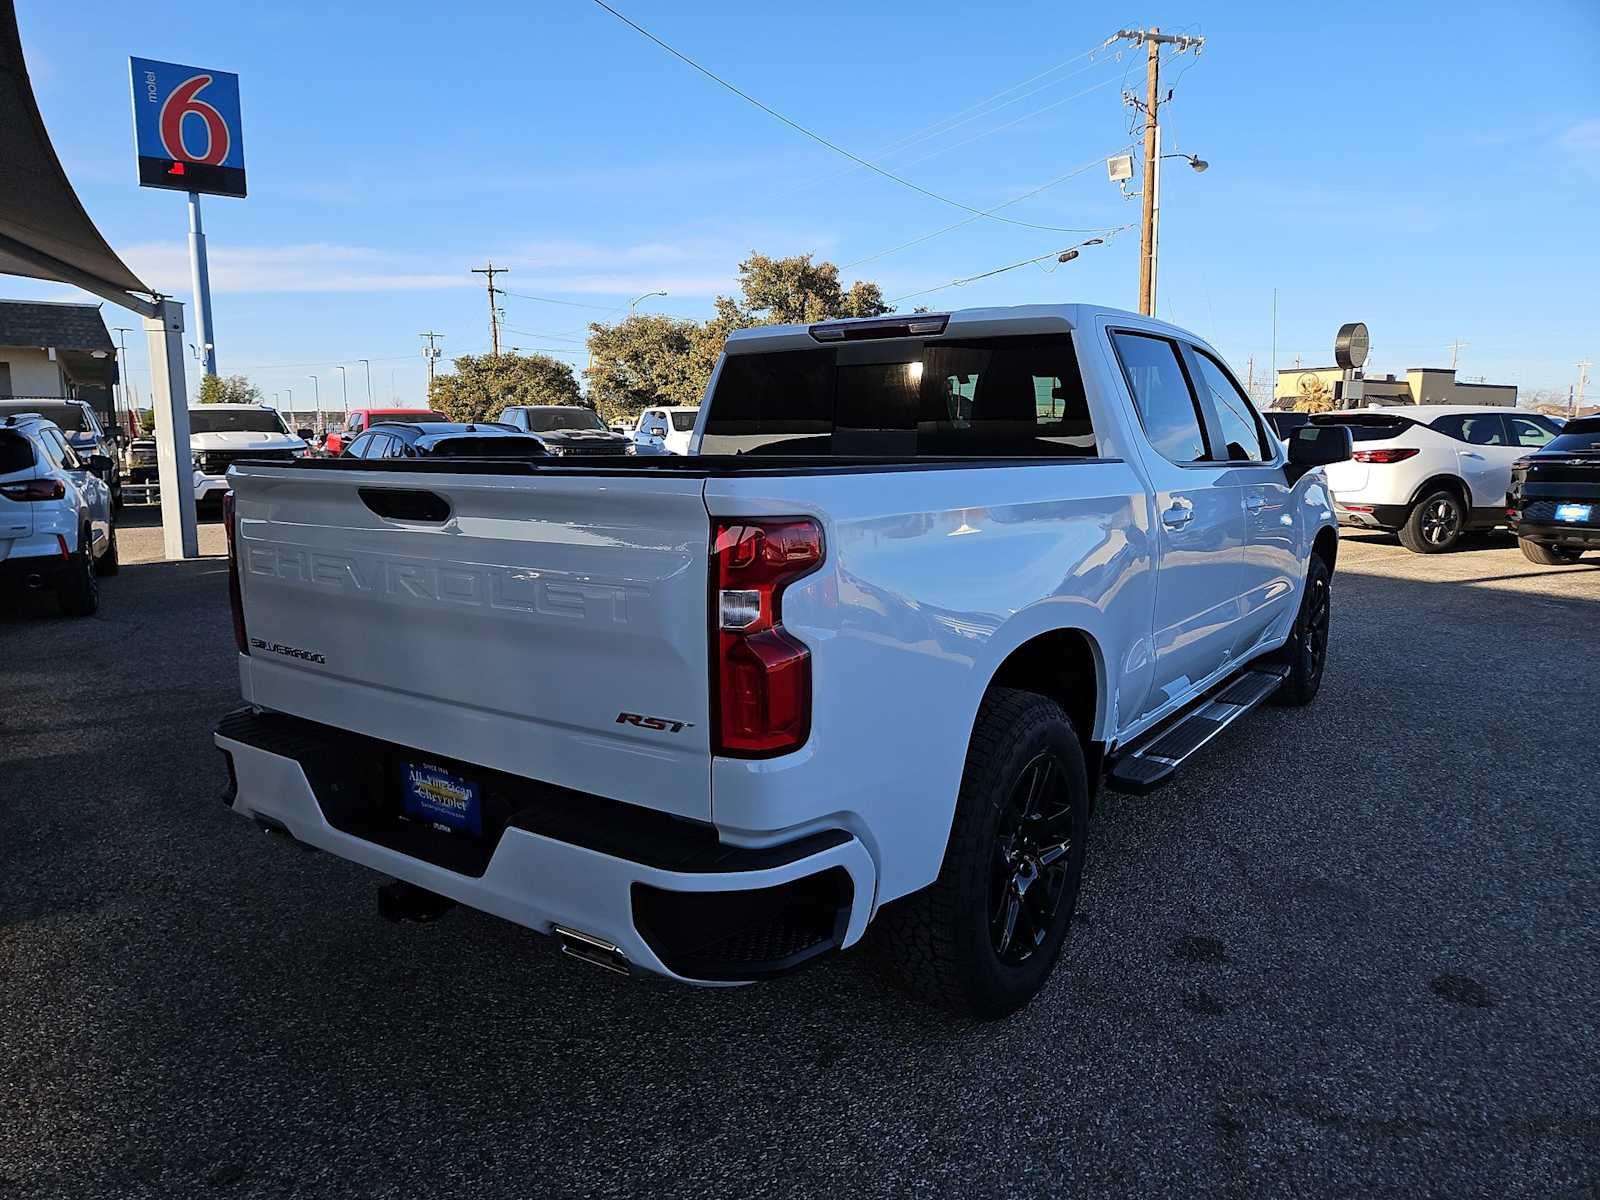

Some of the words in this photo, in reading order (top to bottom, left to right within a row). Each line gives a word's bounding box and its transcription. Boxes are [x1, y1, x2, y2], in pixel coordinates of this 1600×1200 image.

[144, 70, 157, 103] motel
[159, 74, 230, 166] 6
[247, 548, 654, 623] CHEVROLET
[251, 638, 326, 664] SILVERADO
[616, 712, 694, 733] RST
